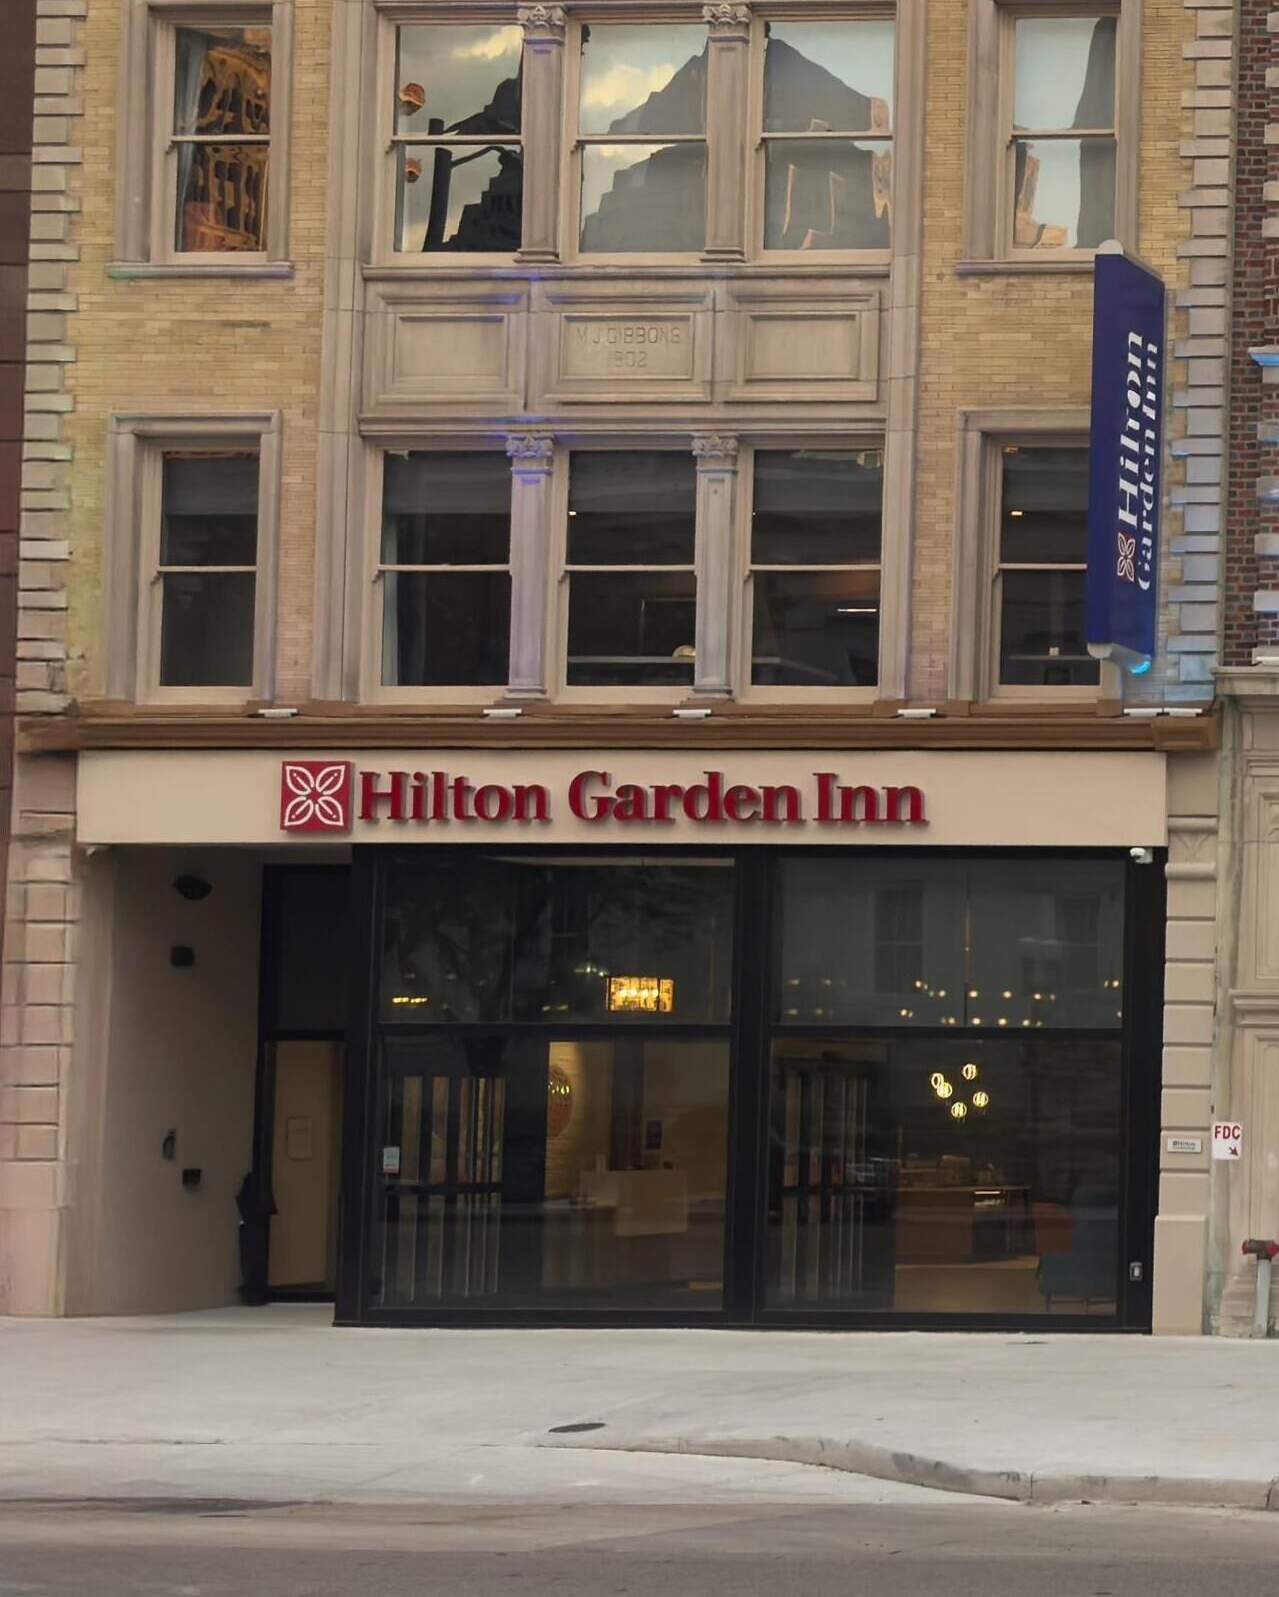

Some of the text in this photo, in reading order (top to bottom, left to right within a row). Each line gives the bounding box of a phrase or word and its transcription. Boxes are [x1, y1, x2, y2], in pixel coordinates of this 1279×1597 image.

[1117, 330, 1143, 529] Hilton
[1138, 341, 1158, 591] Garden Inn
[358, 769, 930, 823] Hilton Garden Inn
[1214, 1125, 1241, 1140] FDC
